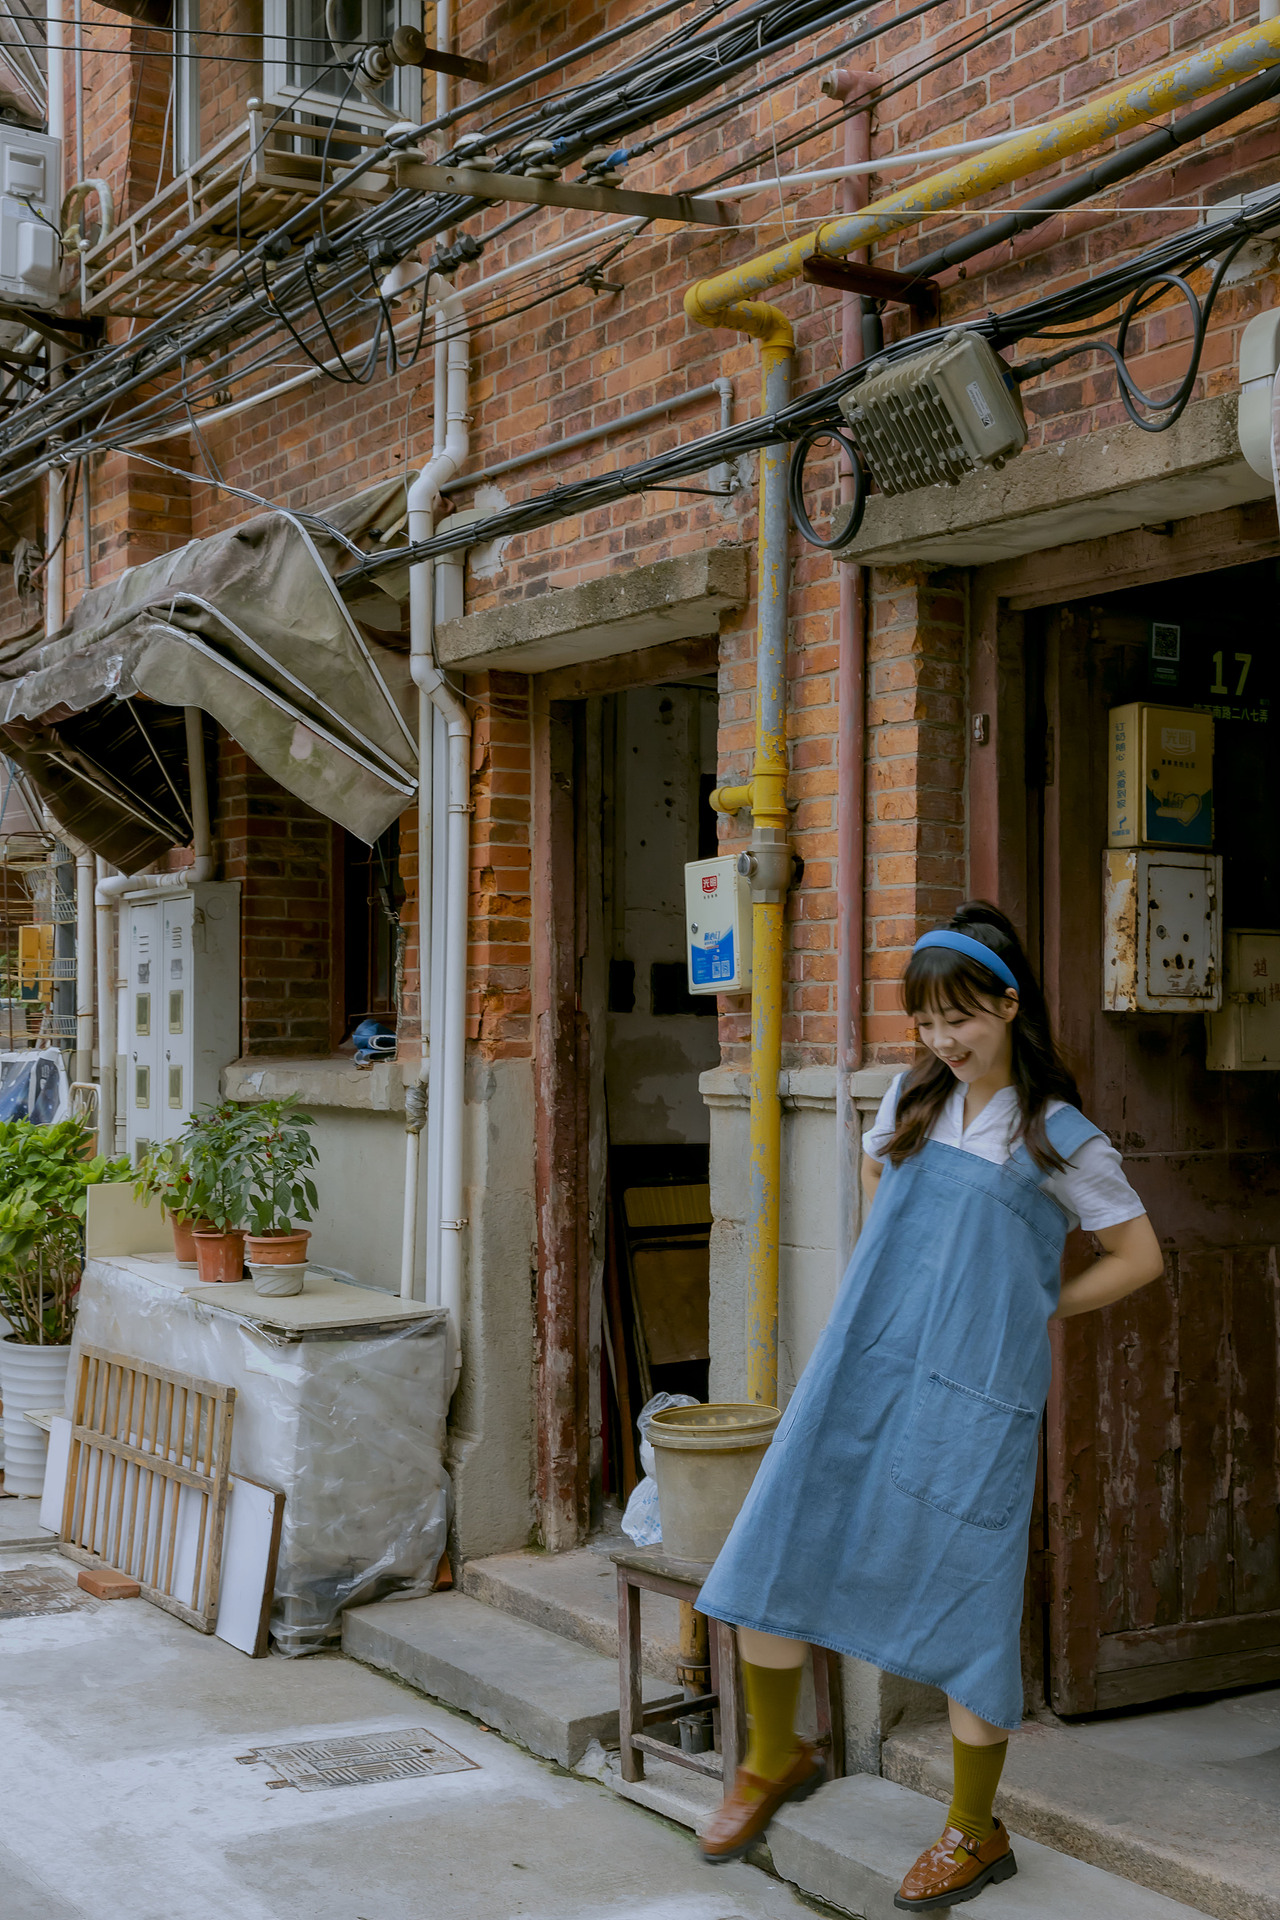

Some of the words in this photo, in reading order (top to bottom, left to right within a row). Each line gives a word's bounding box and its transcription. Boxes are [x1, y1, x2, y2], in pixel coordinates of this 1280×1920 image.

[1210, 650, 1252, 696] 17
[1165, 730, 1191, 745] 光明
[702, 877, 717, 888] 光明
